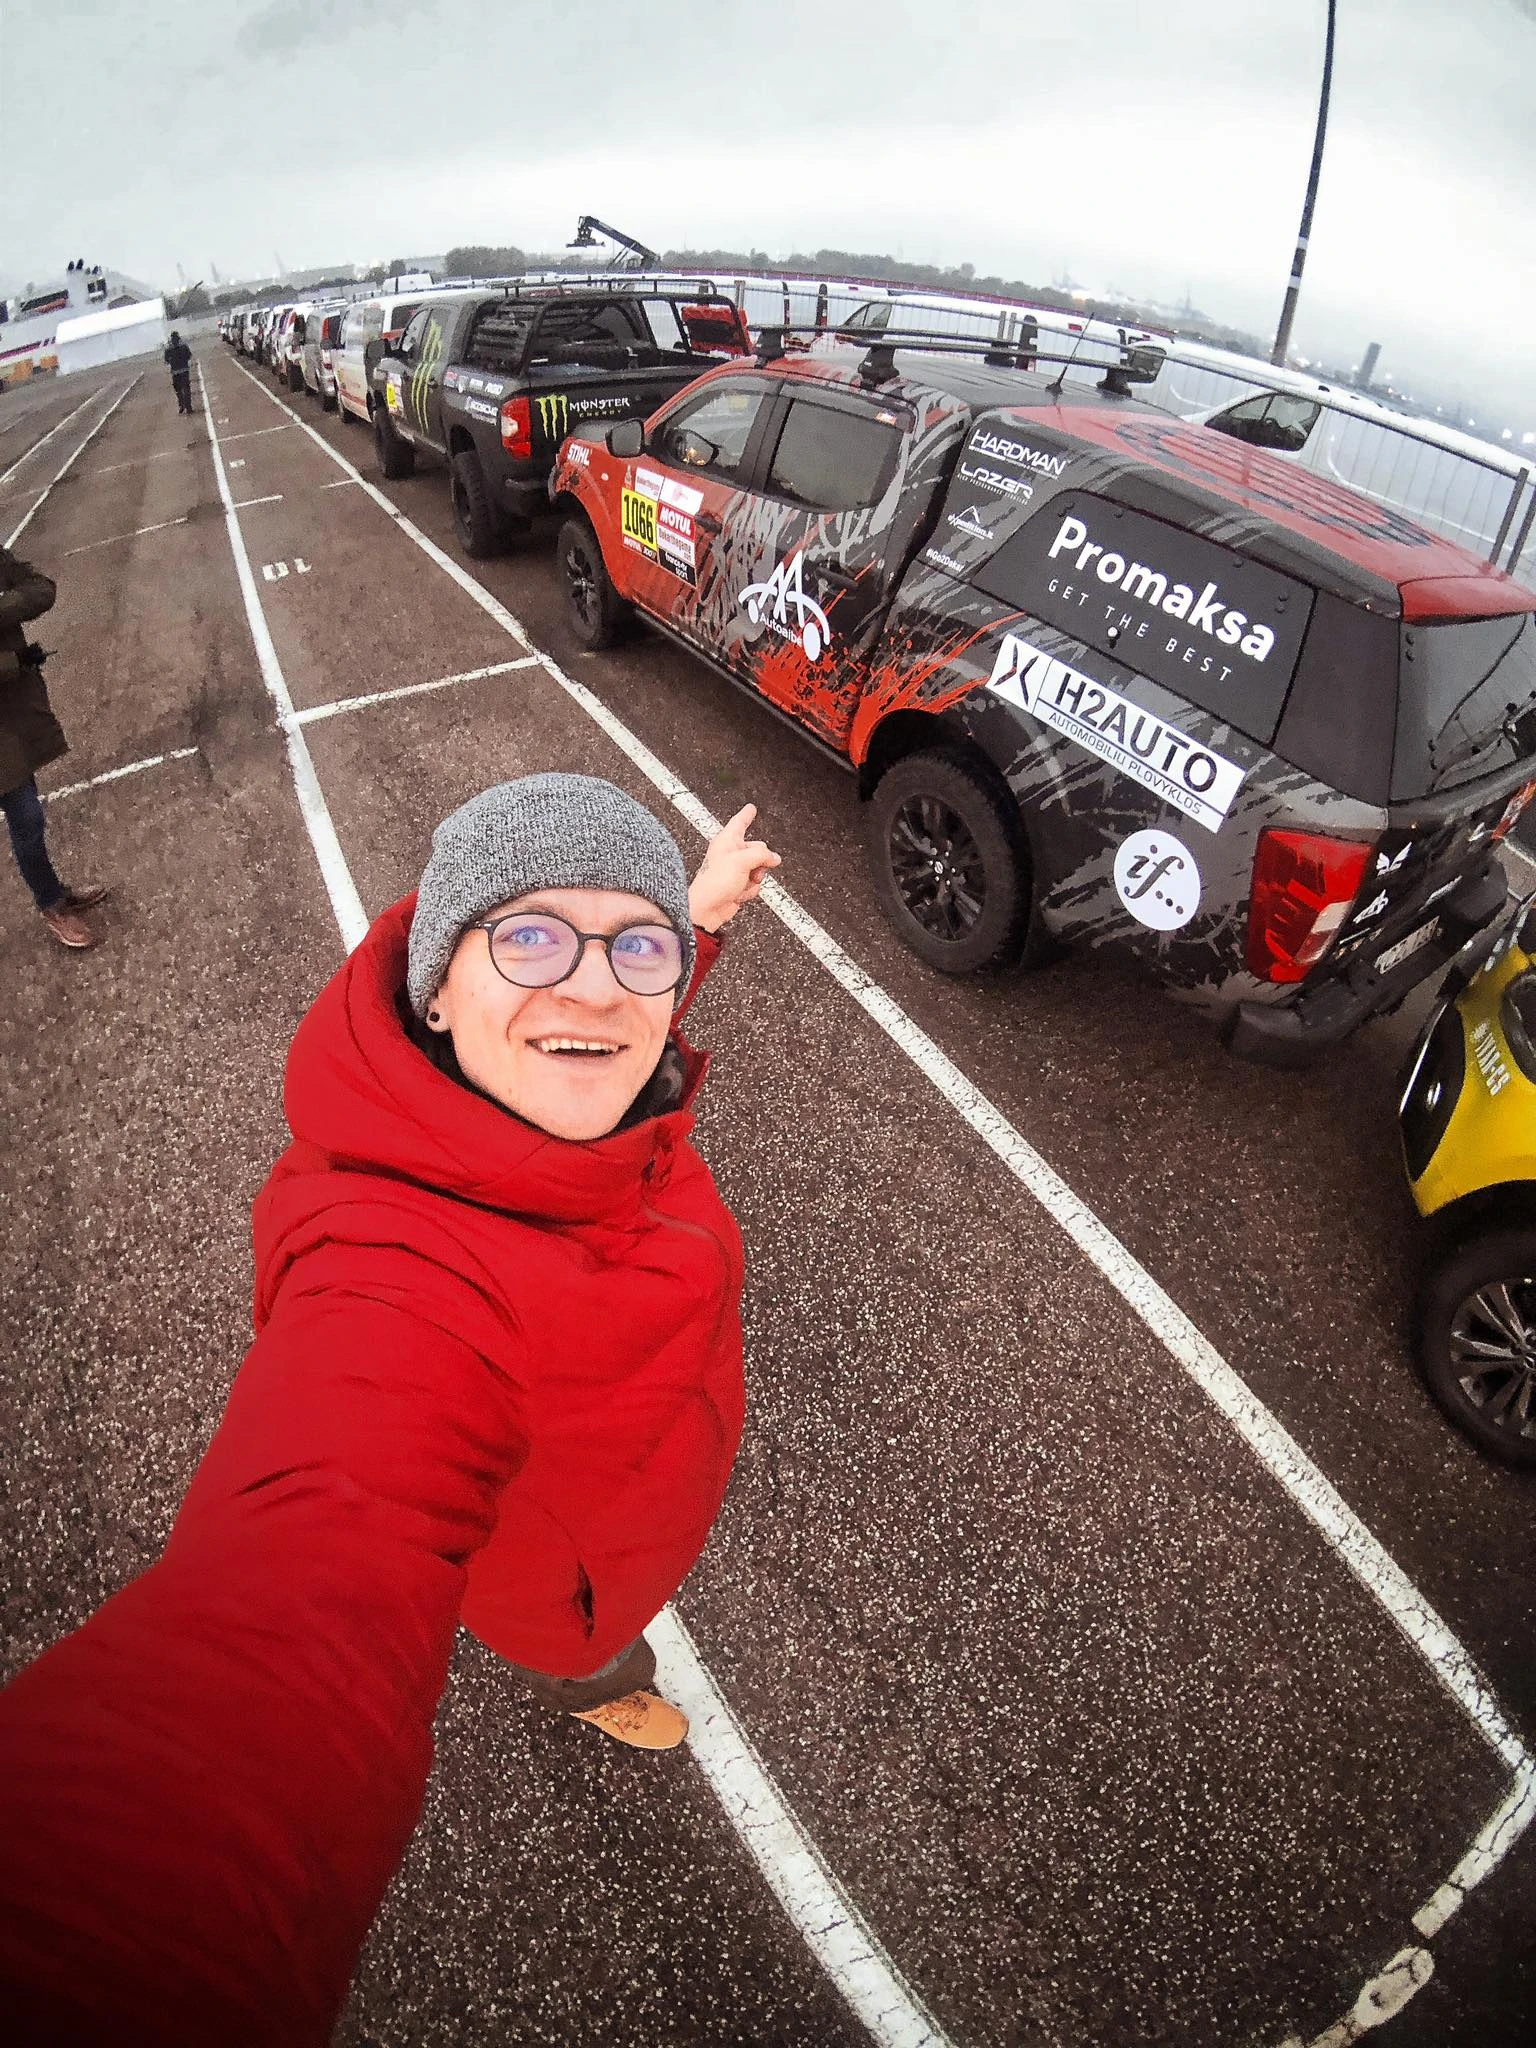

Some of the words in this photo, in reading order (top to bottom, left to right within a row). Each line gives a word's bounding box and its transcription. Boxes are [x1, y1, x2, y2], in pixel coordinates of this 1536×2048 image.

[568, 398, 631, 413] MONSTER
[566, 443, 590, 467] STIHL
[969, 429, 1066, 476] HARDMAN
[623, 494, 654, 545] 1066
[659, 506, 692, 536] MOTUL
[1047, 515, 1275, 663] Promaksa
[1048, 579, 1089, 607] GET
[1103, 605, 1149, 638] THE
[1165, 637, 1232, 681] BEST
[1054, 671, 1218, 793] H2AUTO
[1127, 761, 1203, 816] PLOVYKLOS
